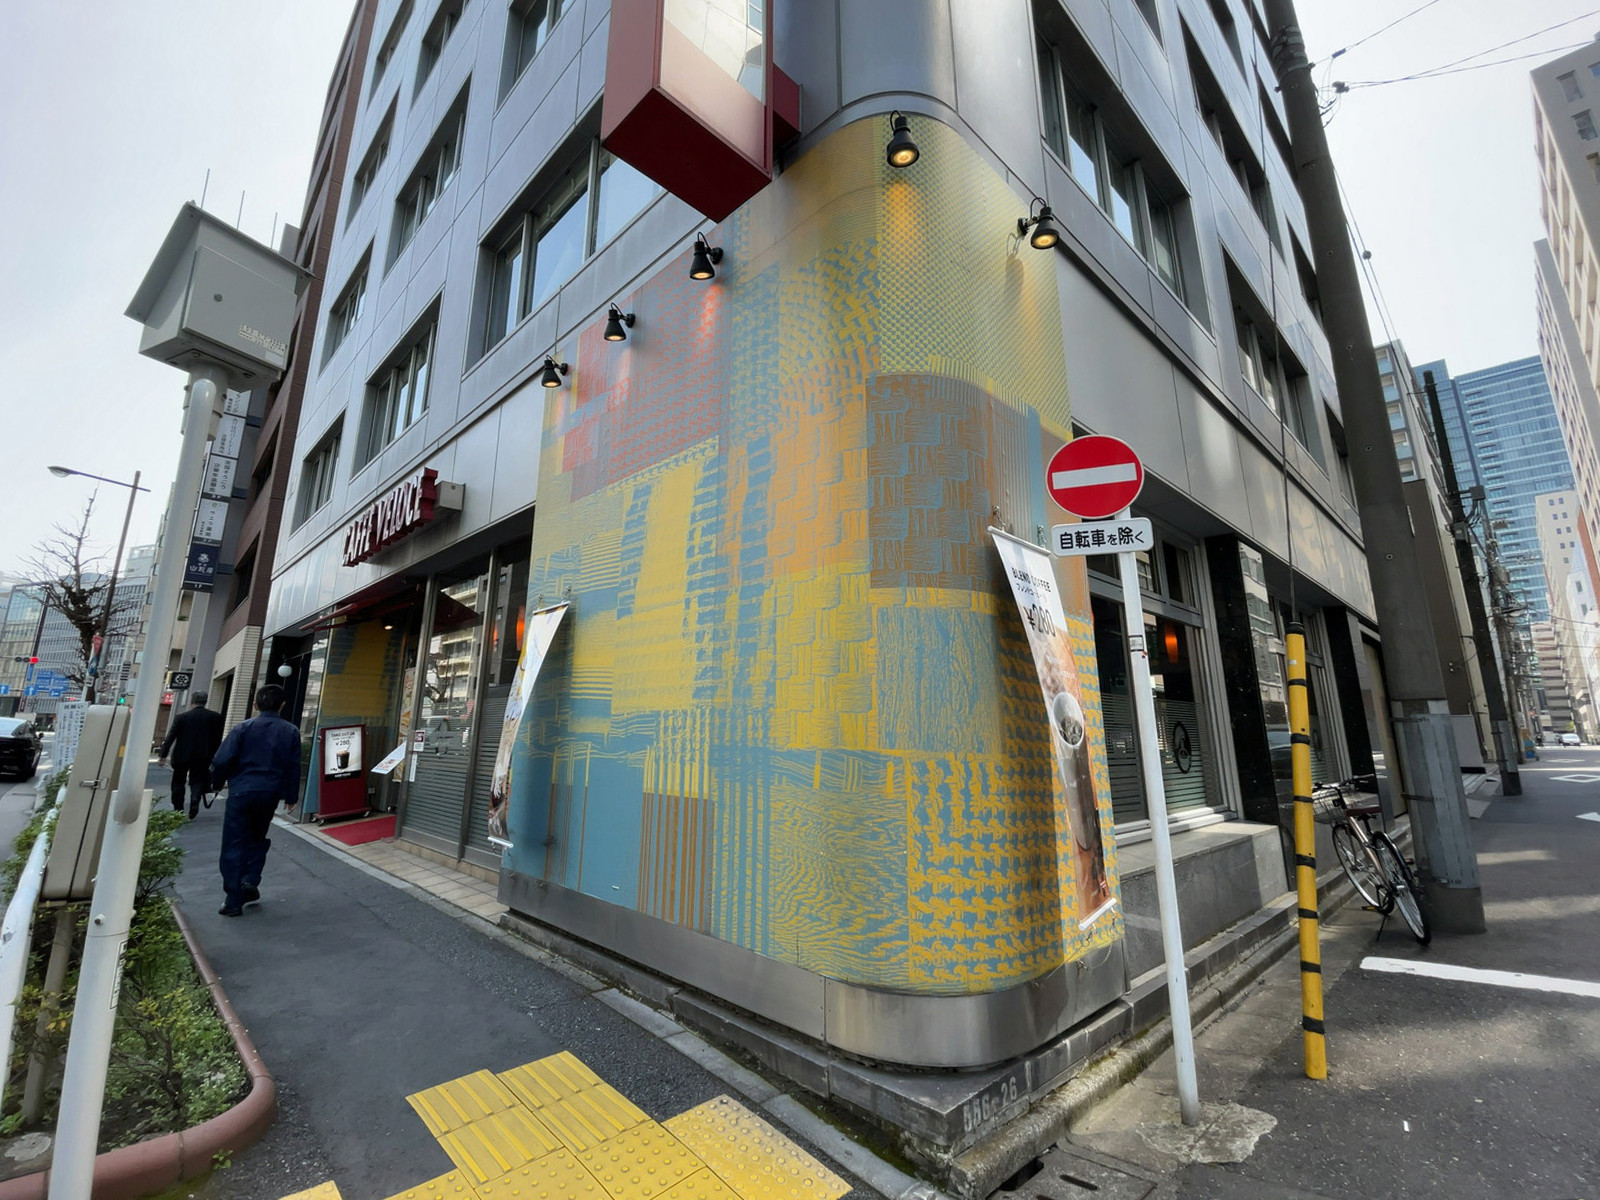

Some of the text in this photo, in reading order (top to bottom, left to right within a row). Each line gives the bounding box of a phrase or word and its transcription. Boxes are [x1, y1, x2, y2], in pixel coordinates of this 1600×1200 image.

[376, 467, 425, 546] VELOCE
[1060, 527, 1145, 549] 自転車を除く
[1011, 567, 1051, 593] BLEND COFFEE
[1023, 603, 1056, 638] ¥280
